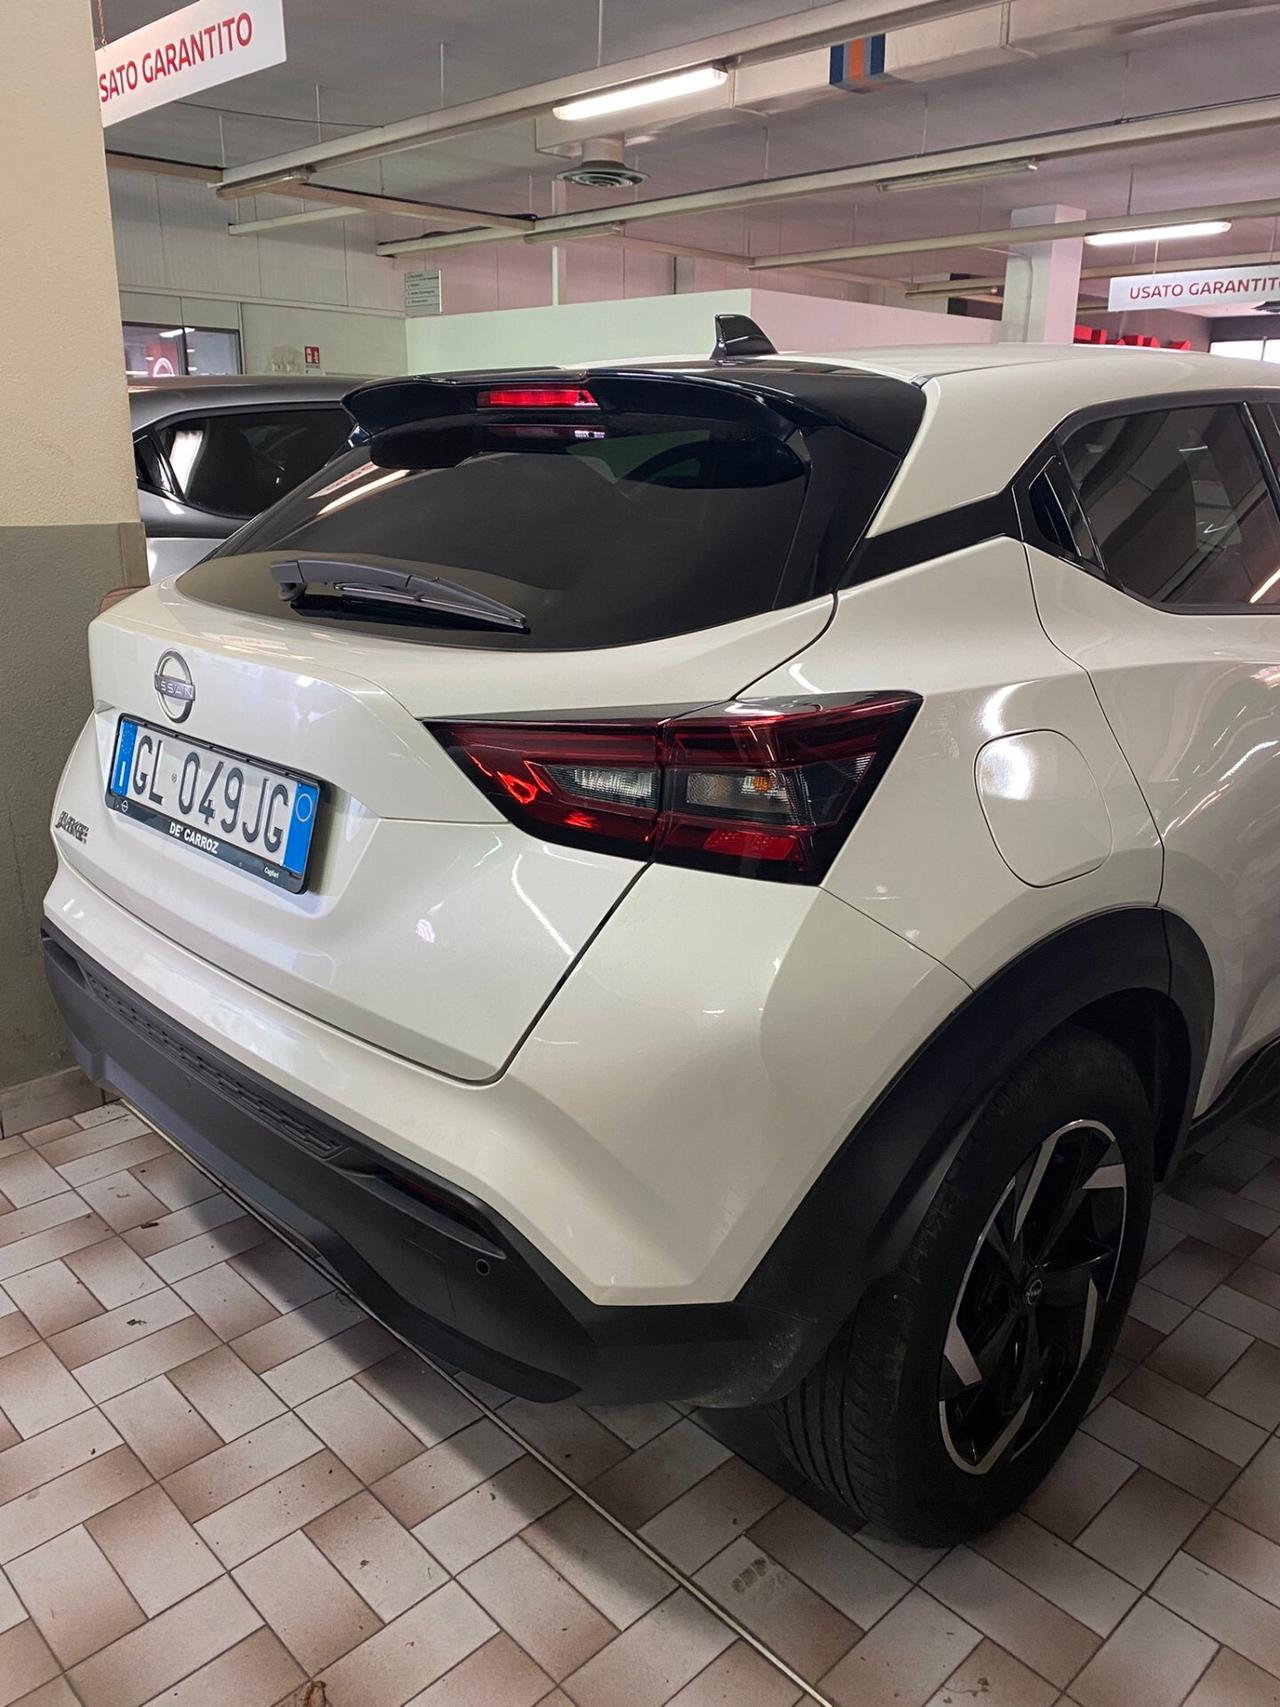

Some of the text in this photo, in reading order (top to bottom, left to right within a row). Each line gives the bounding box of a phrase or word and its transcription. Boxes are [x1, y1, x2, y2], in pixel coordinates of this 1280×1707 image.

[99, 12, 253, 103] SATO GARANTITO
[1129, 276, 1280, 300] USATO GARANTIT
[184, 829, 219, 854] CARROZ
